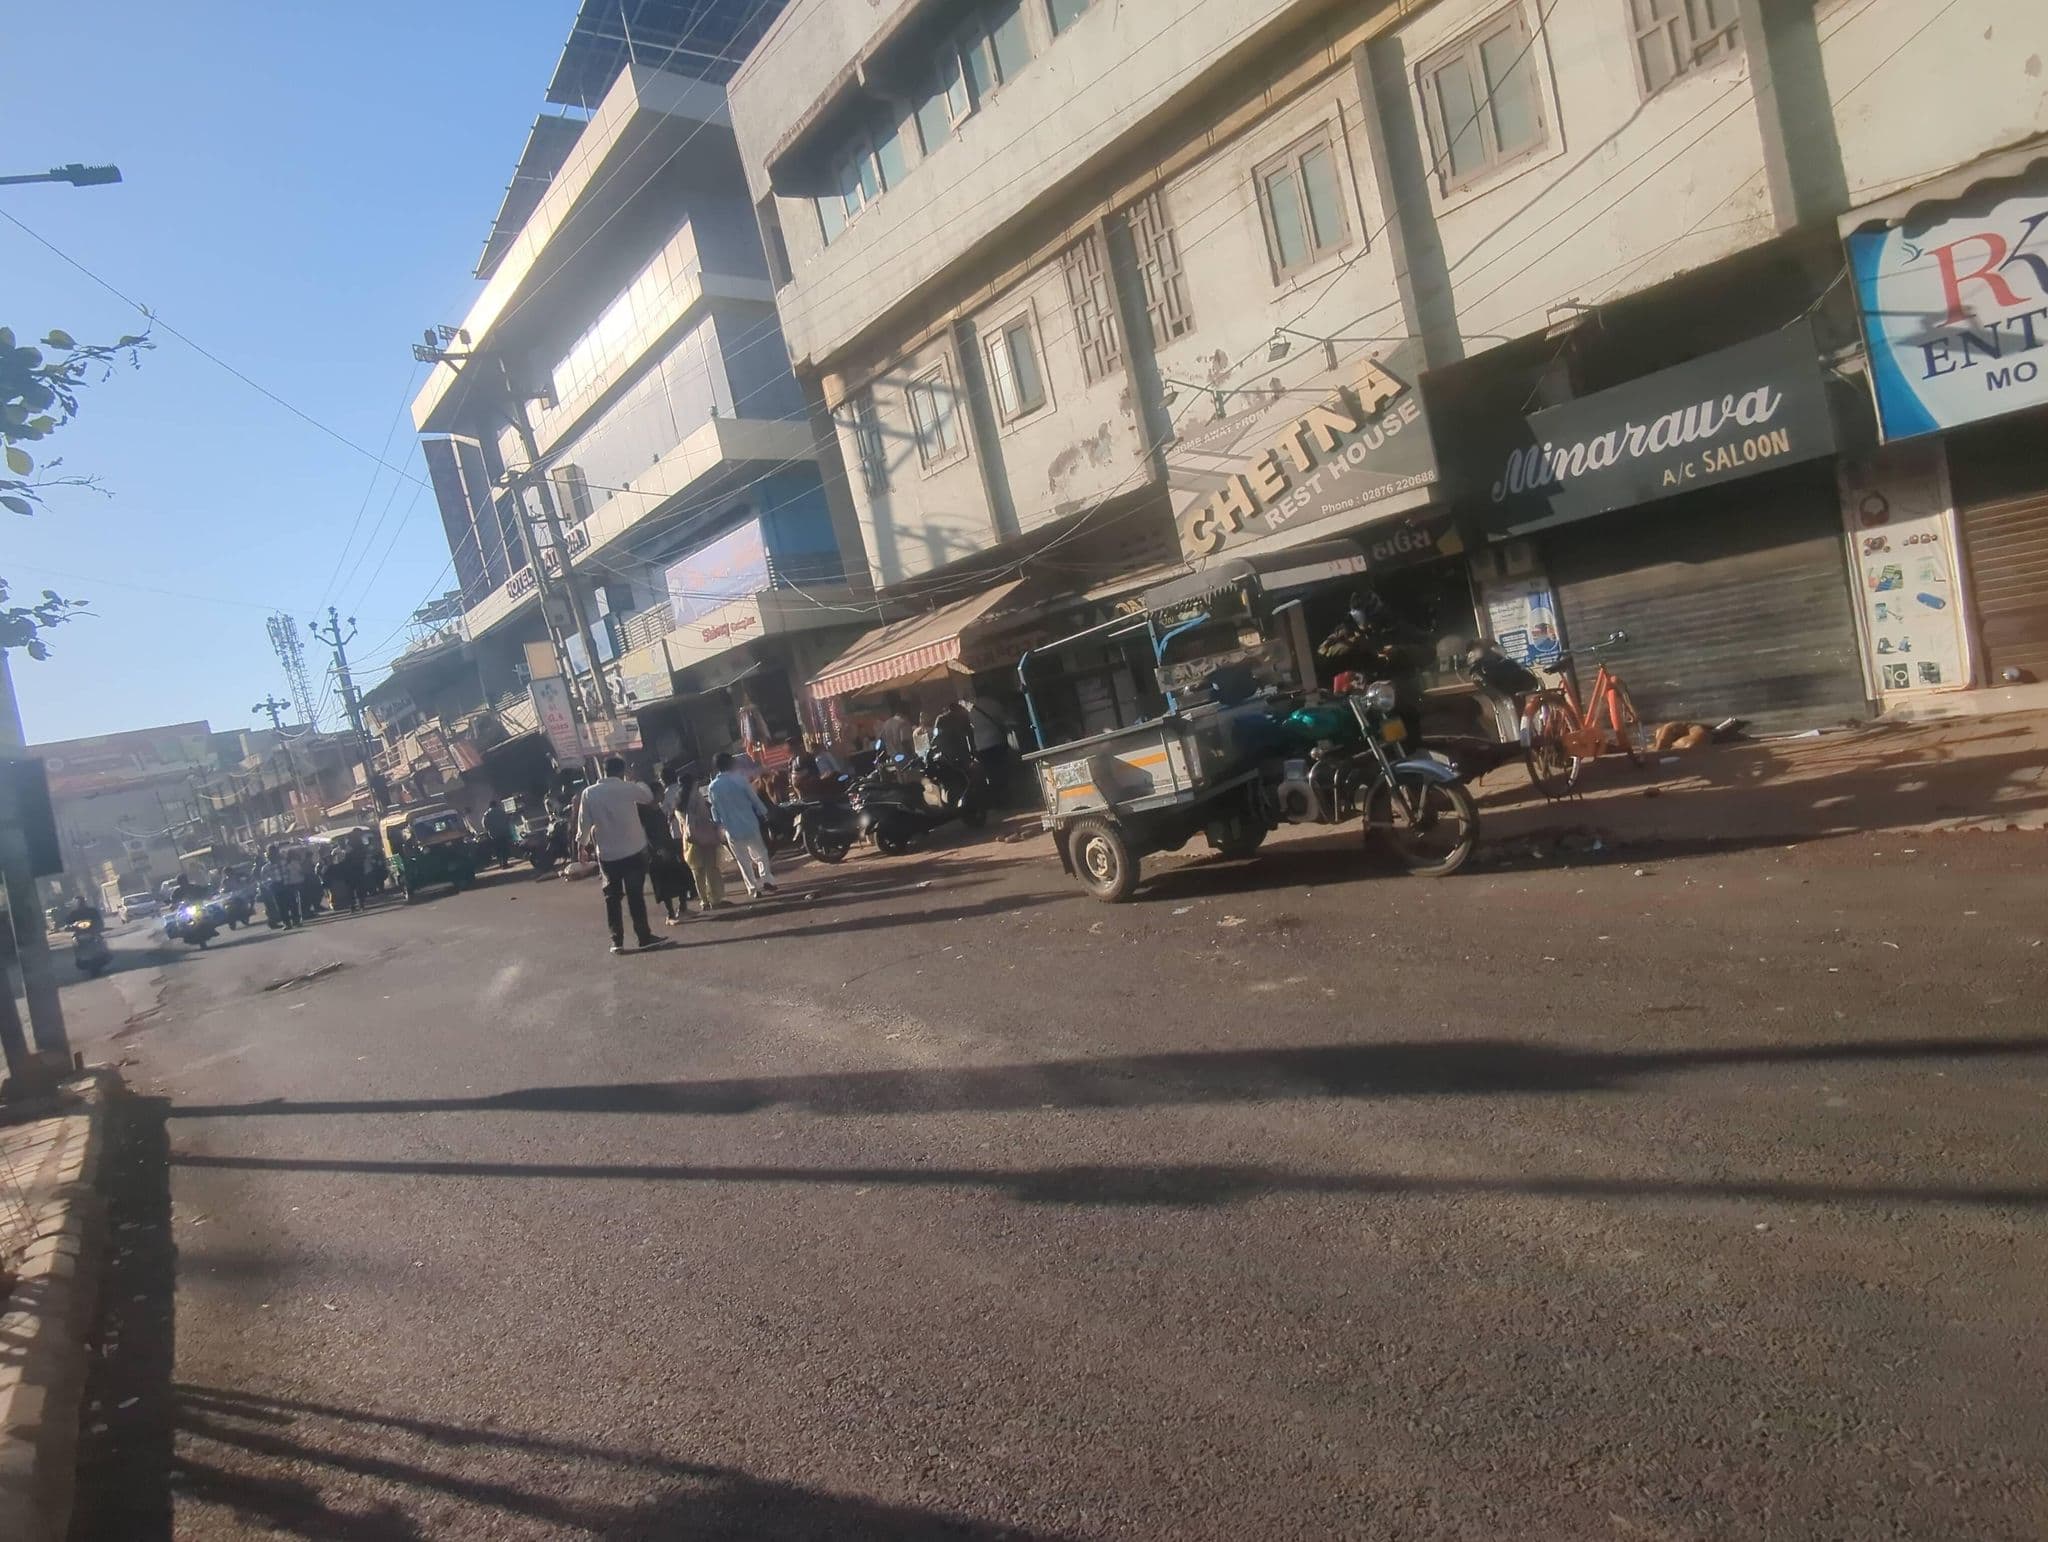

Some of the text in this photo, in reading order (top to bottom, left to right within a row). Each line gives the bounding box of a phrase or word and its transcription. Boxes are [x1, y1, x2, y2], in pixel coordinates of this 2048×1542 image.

[1180, 357, 1405, 554] CHETNA
[1264, 397, 1422, 531] REST HOUSE
[1362, 483, 1395, 502] 02876
[1702, 427, 1791, 474] SALOON
